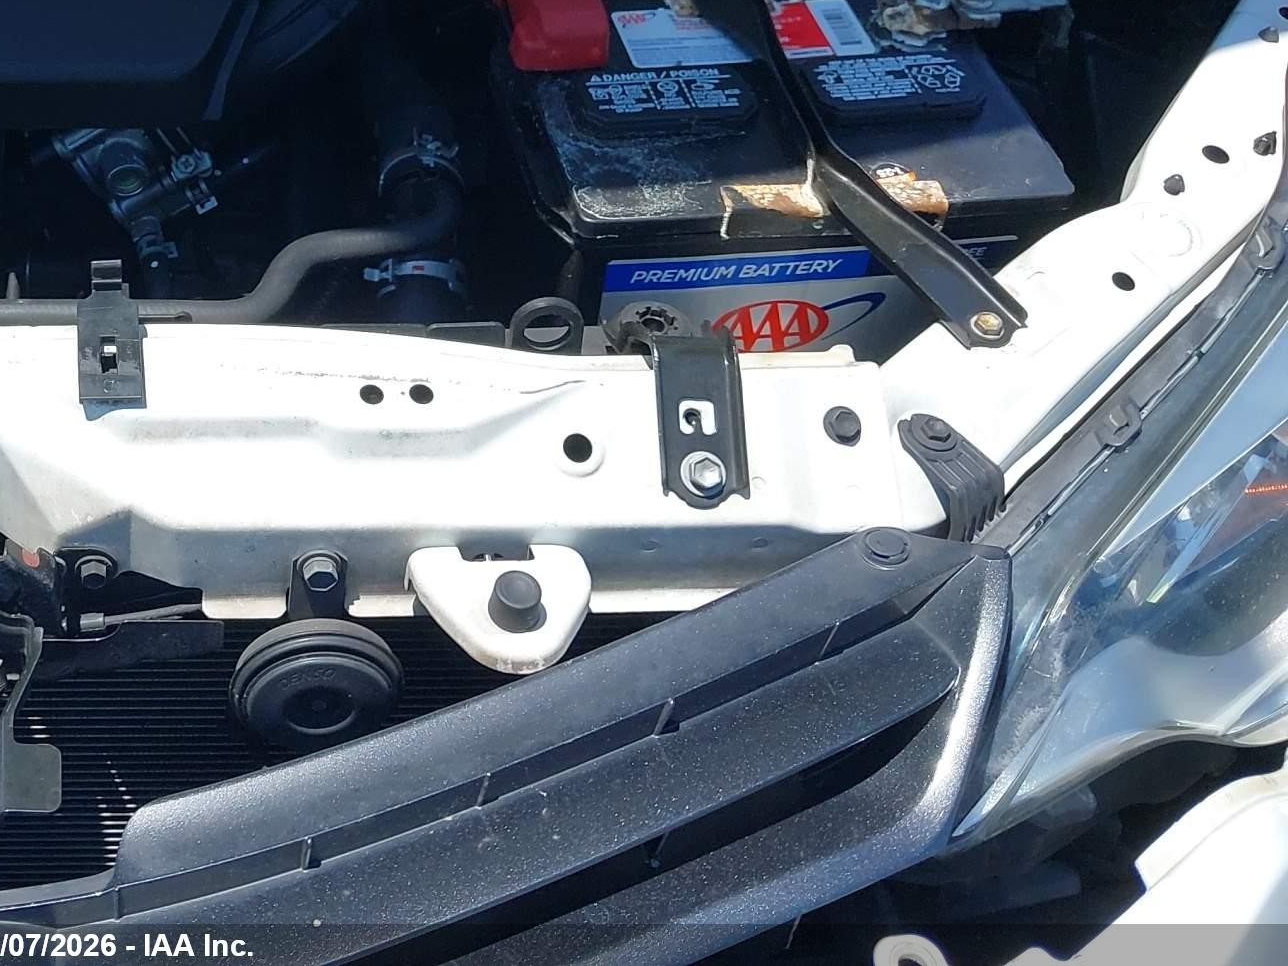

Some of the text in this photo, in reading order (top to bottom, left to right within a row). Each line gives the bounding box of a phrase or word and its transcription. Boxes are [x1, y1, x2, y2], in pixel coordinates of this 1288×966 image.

[602, 71, 657, 82] DANGER
[669, 68, 719, 78] POISON
[629, 258, 843, 284] PREMIUM BATTERY
[718, 301, 824, 353] AAA
